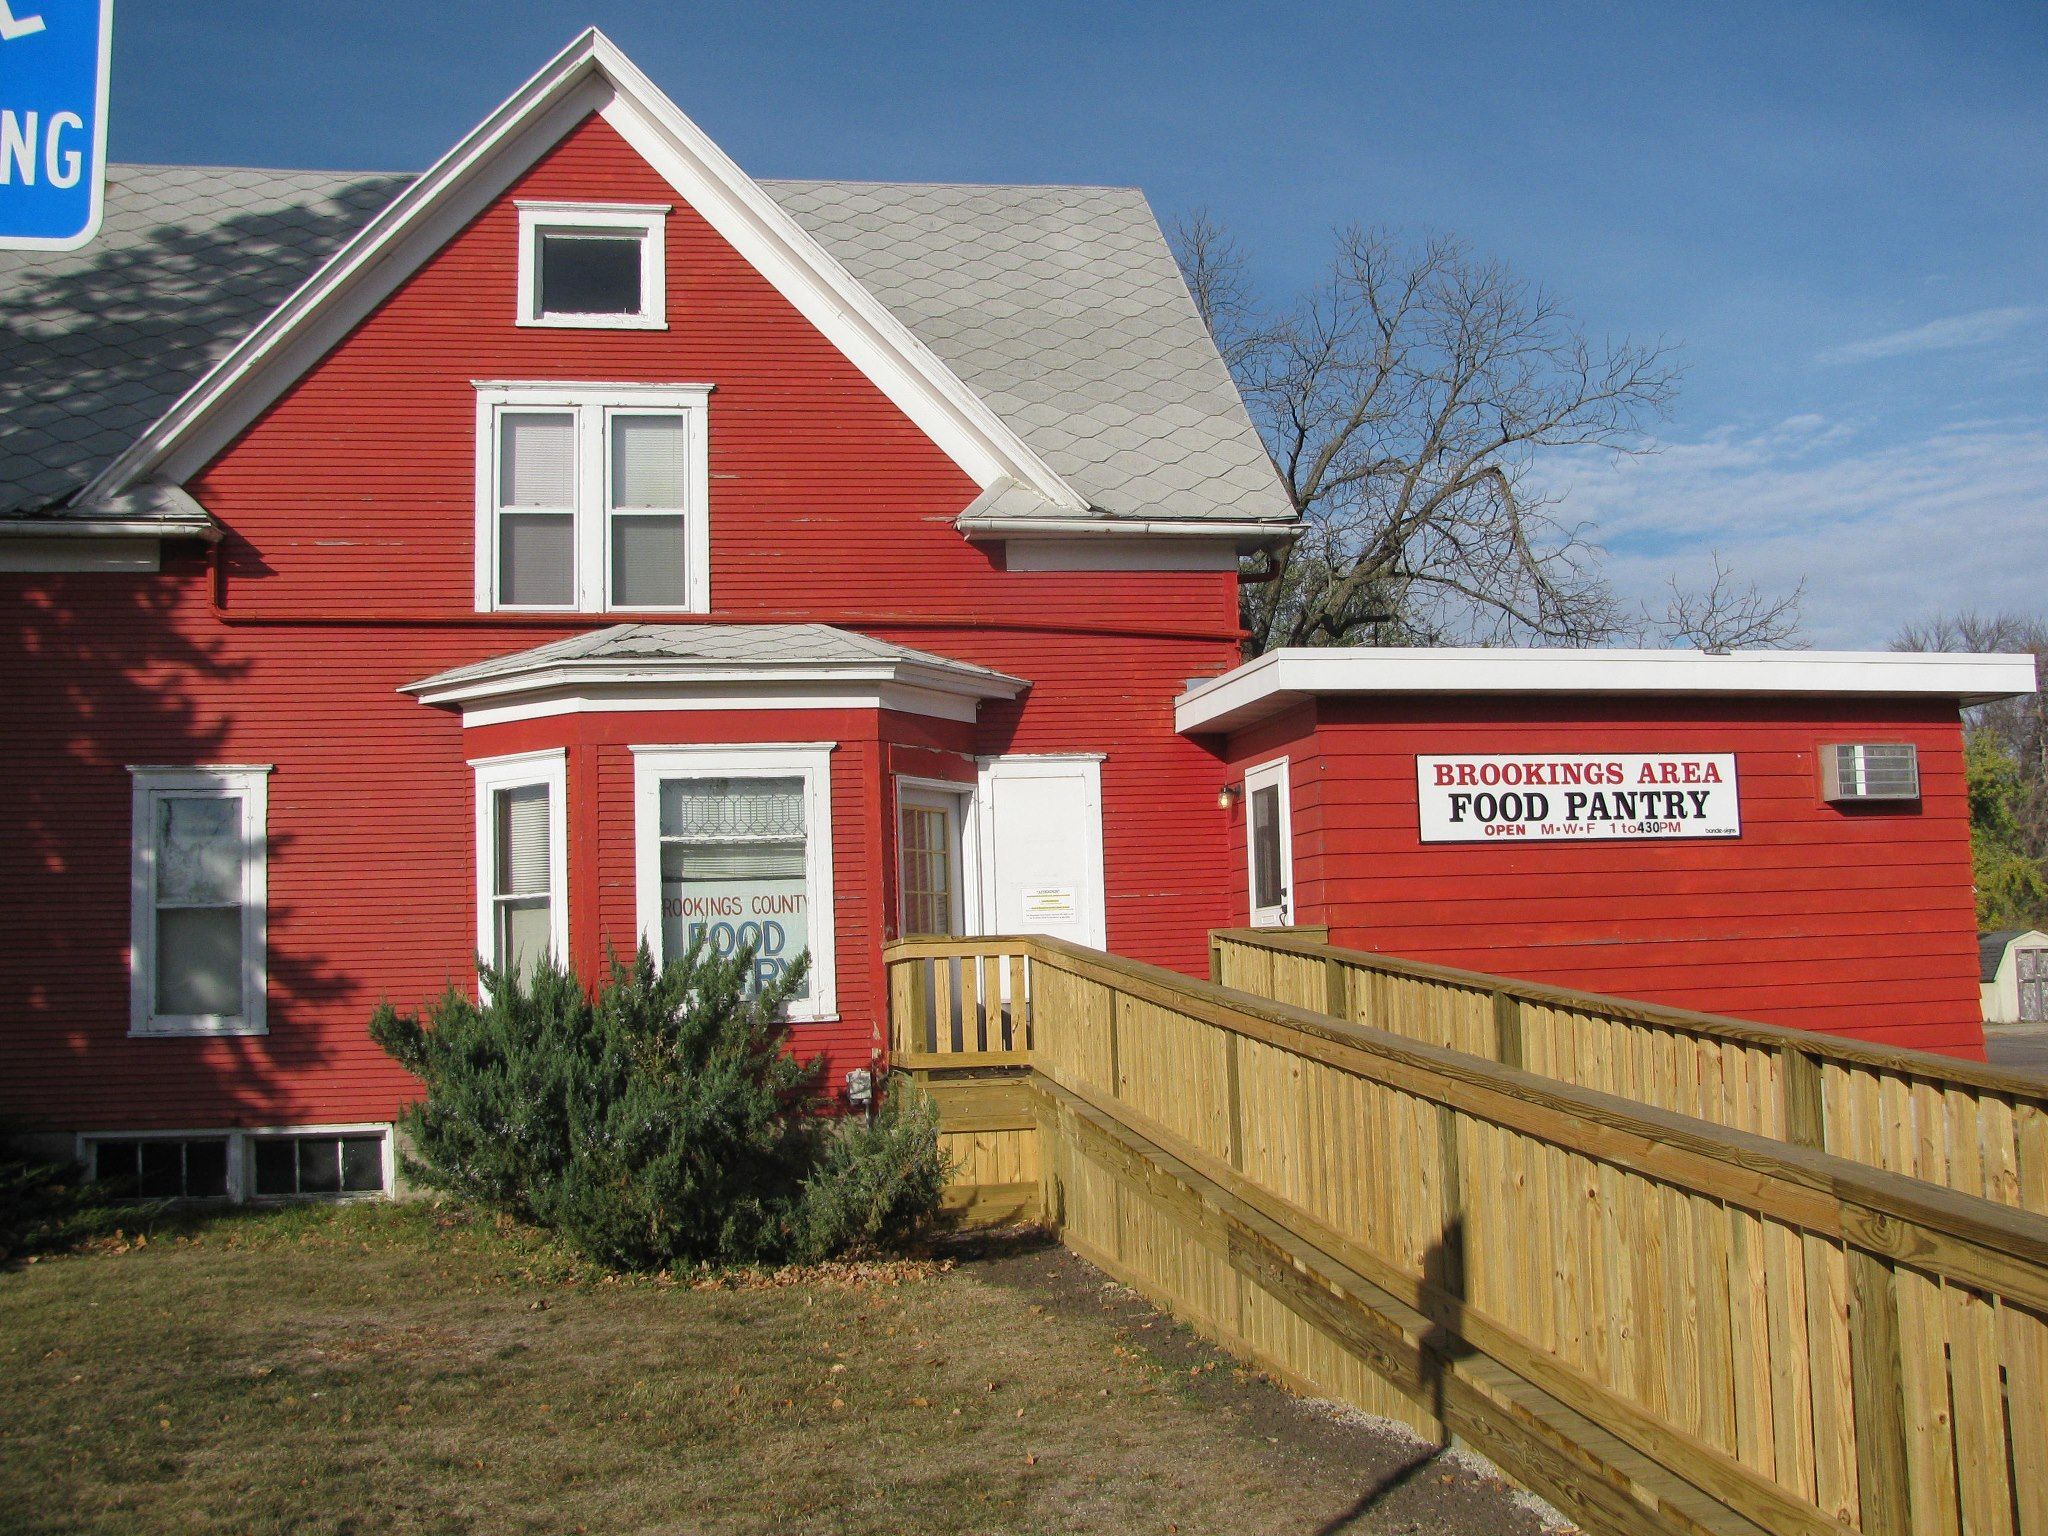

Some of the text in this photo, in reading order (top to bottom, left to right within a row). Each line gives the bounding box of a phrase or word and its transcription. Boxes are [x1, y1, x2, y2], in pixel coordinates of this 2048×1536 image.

[1433, 762, 1723, 786] BROOKINGS AREA
[1448, 790, 1710, 823] FOOD PANTRY
[1484, 824, 1526, 836] OPEN
[688, 920, 786, 957] FOOD
